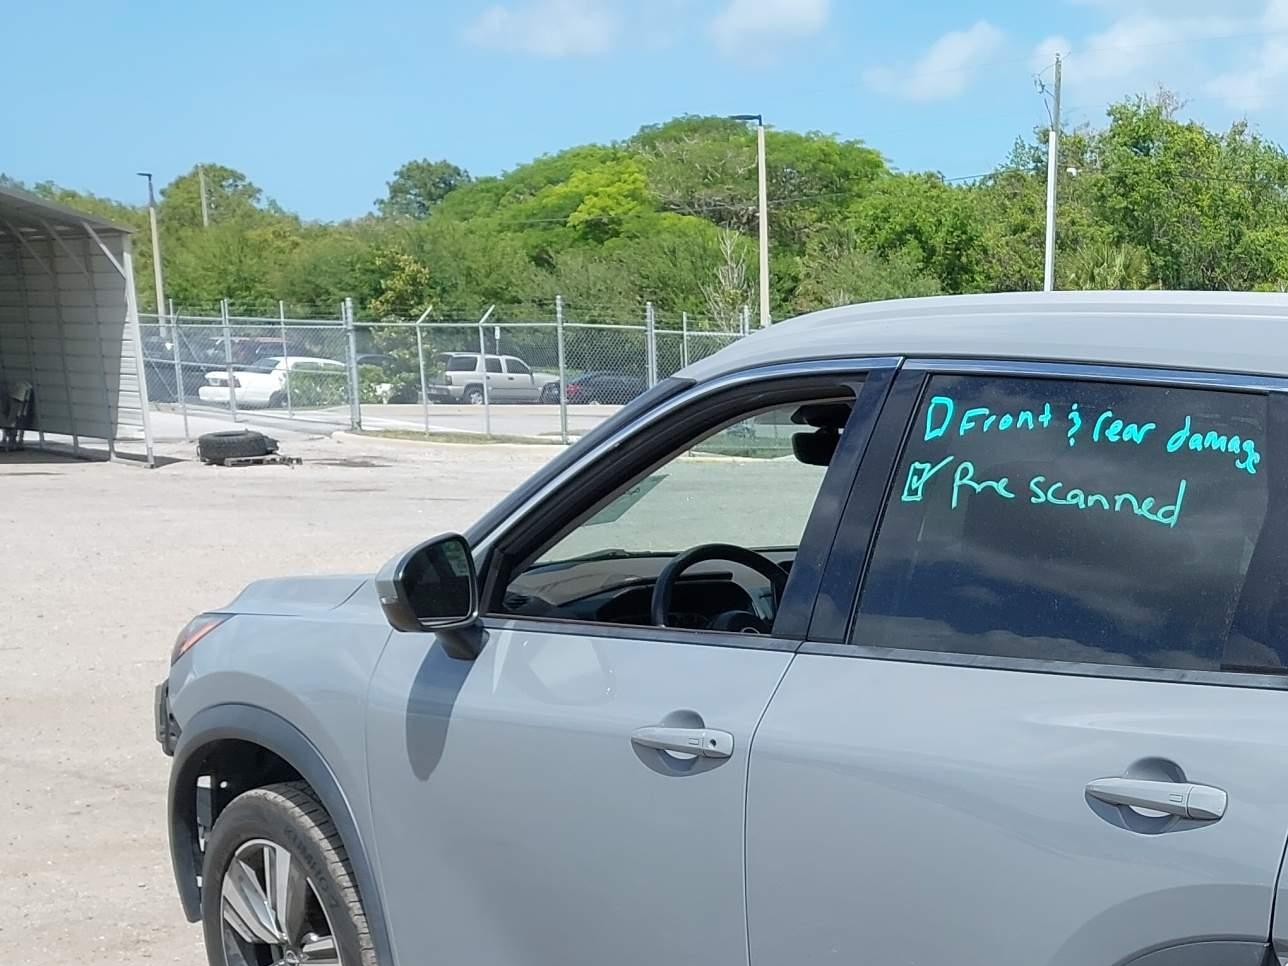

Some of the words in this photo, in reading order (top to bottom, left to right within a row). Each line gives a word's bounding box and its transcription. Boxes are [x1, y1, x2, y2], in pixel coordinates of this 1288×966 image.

[958, 402, 1052, 436] Front
[1092, 409, 1157, 445] rear
[1029, 476, 1188, 528] scanned
